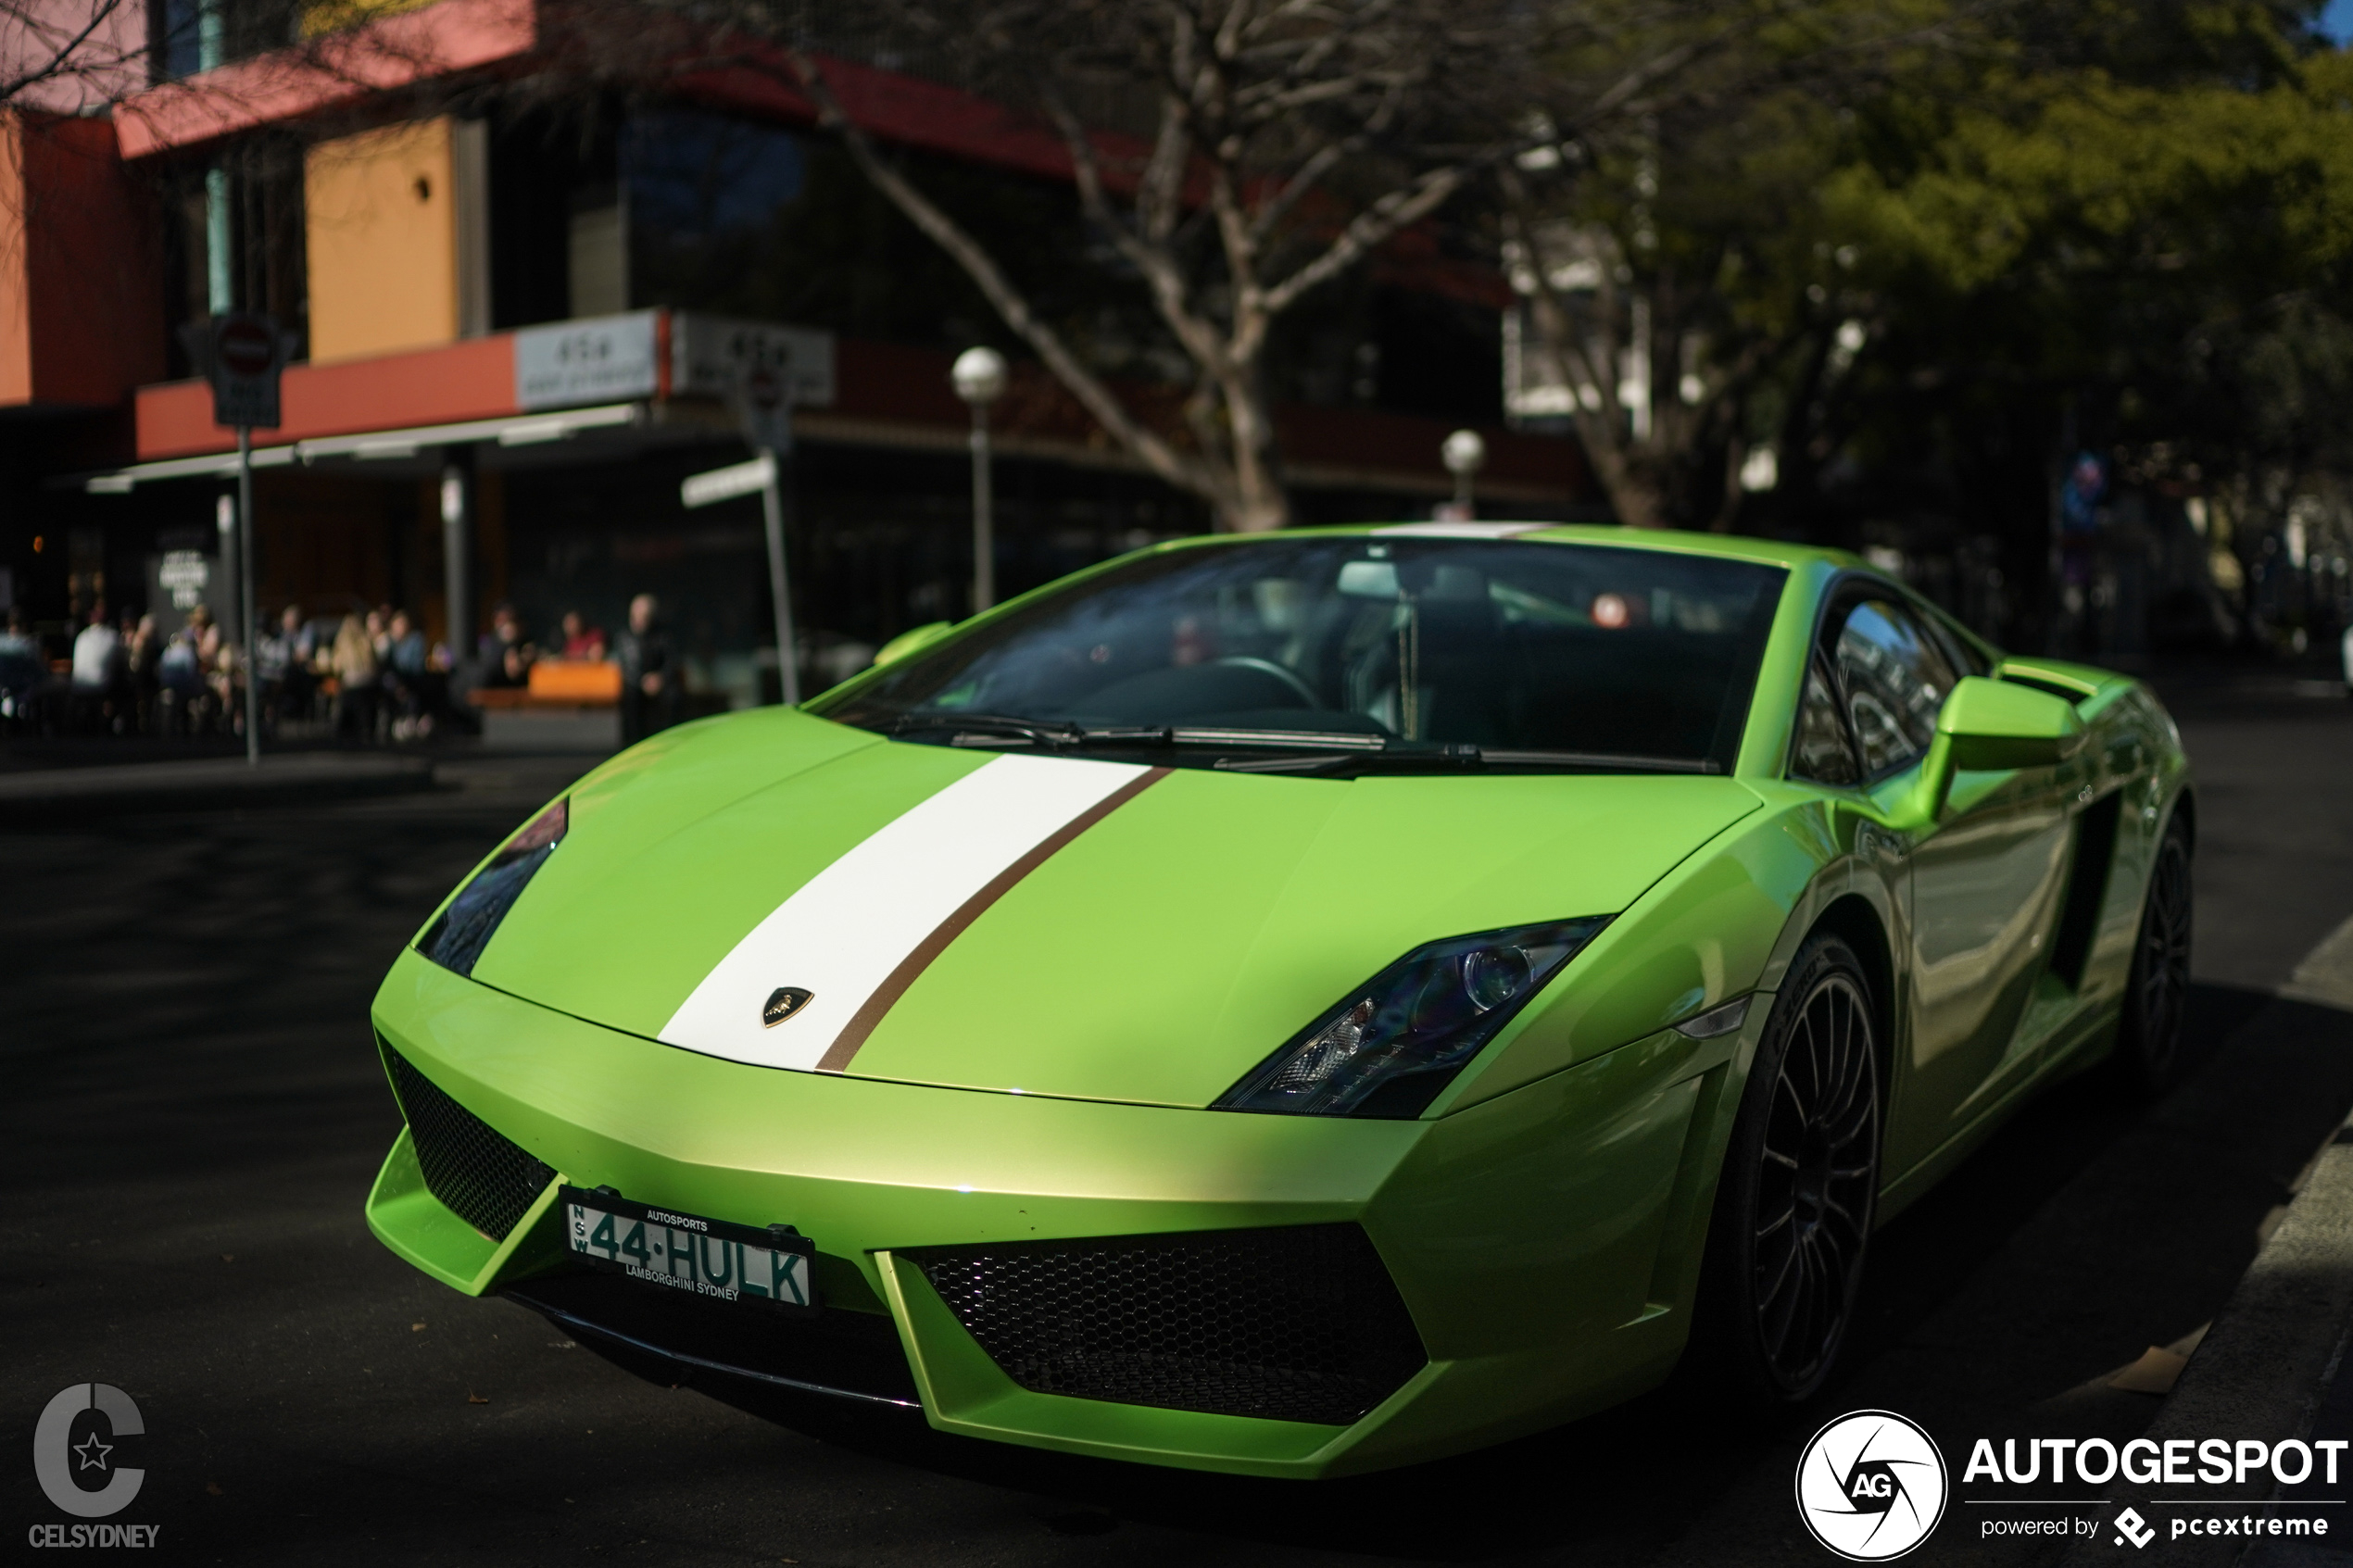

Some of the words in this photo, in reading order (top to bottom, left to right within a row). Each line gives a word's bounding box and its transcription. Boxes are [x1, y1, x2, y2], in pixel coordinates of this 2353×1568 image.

[573, 1204, 588, 1253] NSW
[647, 1209, 708, 1232] AUTOSPORTS
[625, 1263, 695, 1293] LAMBORGHINI
[697, 1282, 739, 1301] SYDNEY
